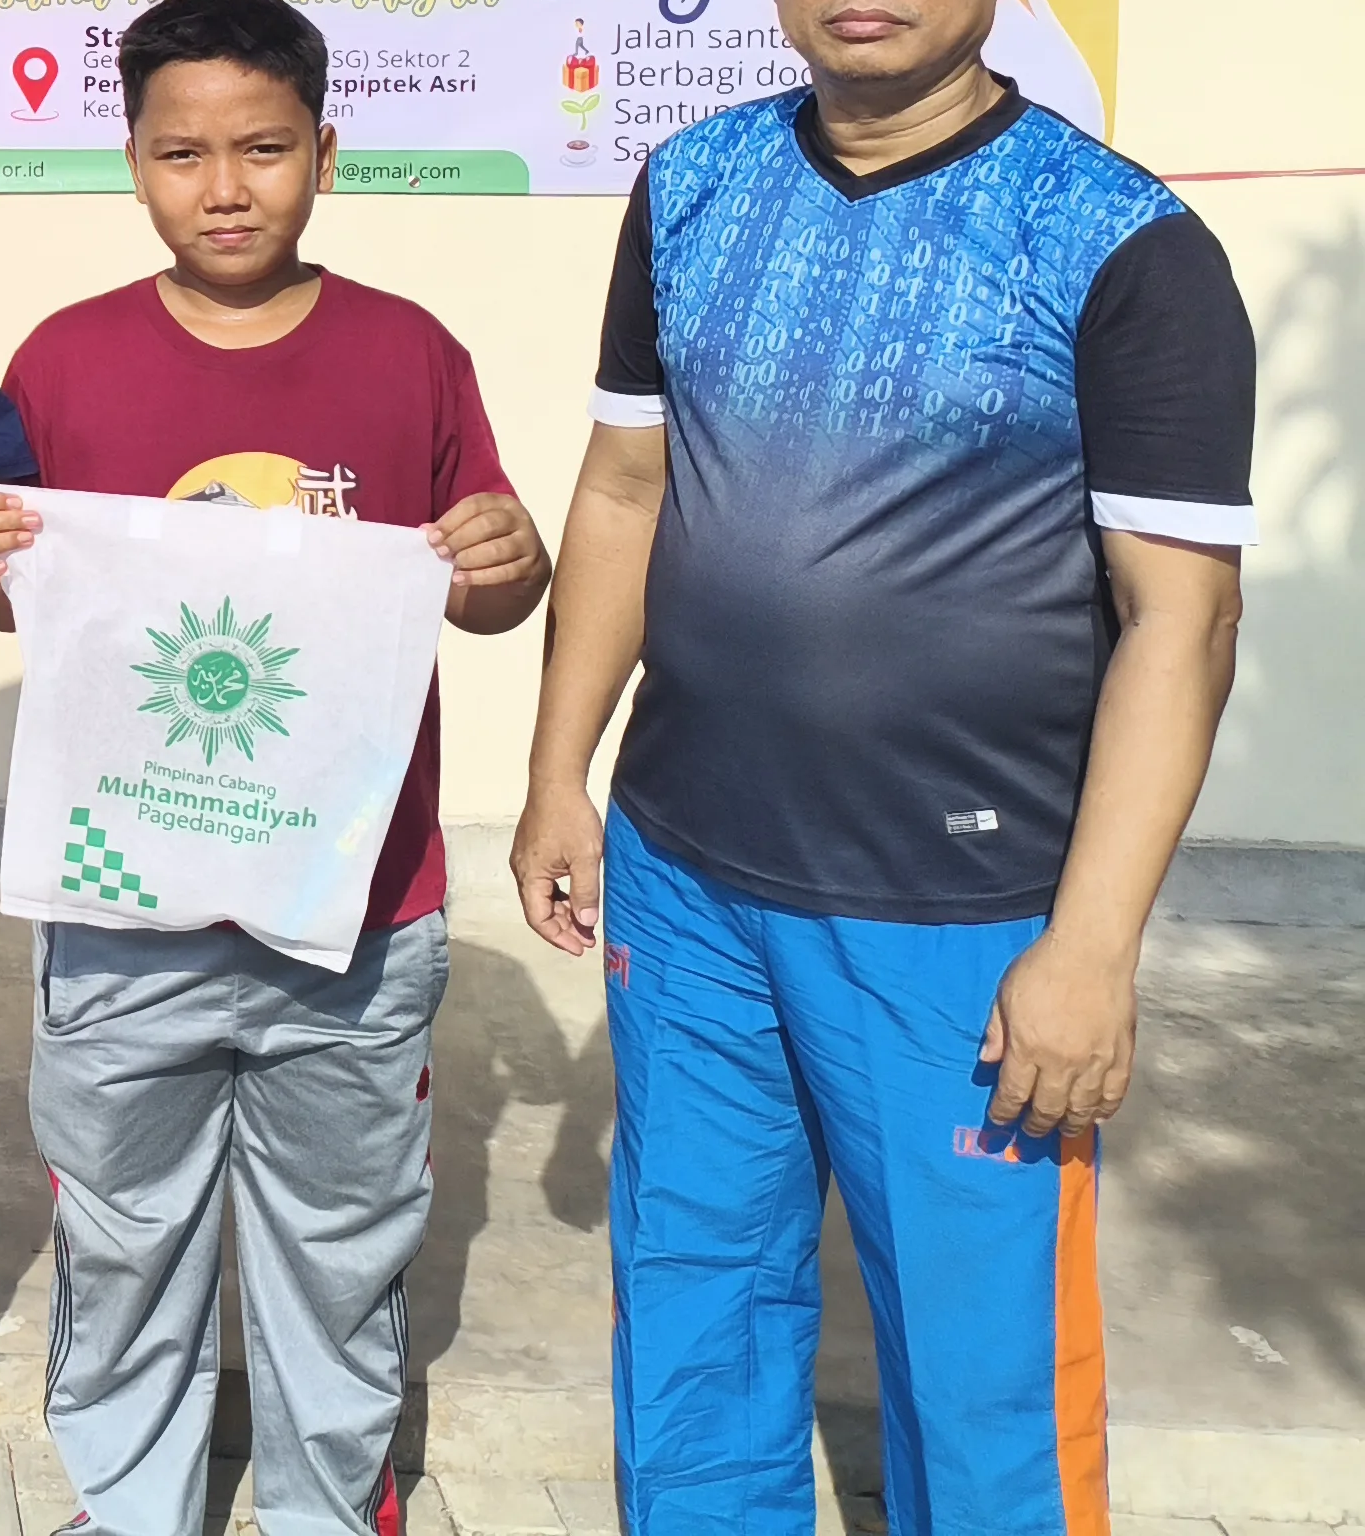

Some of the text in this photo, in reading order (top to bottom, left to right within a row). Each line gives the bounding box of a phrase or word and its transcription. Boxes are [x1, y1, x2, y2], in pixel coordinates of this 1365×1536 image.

[611, 21, 694, 56] Jalan
[376, 49, 451, 69] Sektor
[457, 49, 471, 69] 2
[429, 74, 477, 93] Asri
[616, 60, 743, 95] Berbagi
[142, 759, 278, 800] Pimpinan Cabang
[96, 774, 318, 830] Muhammadiyah
[137, 801, 272, 846] Pagedangan
